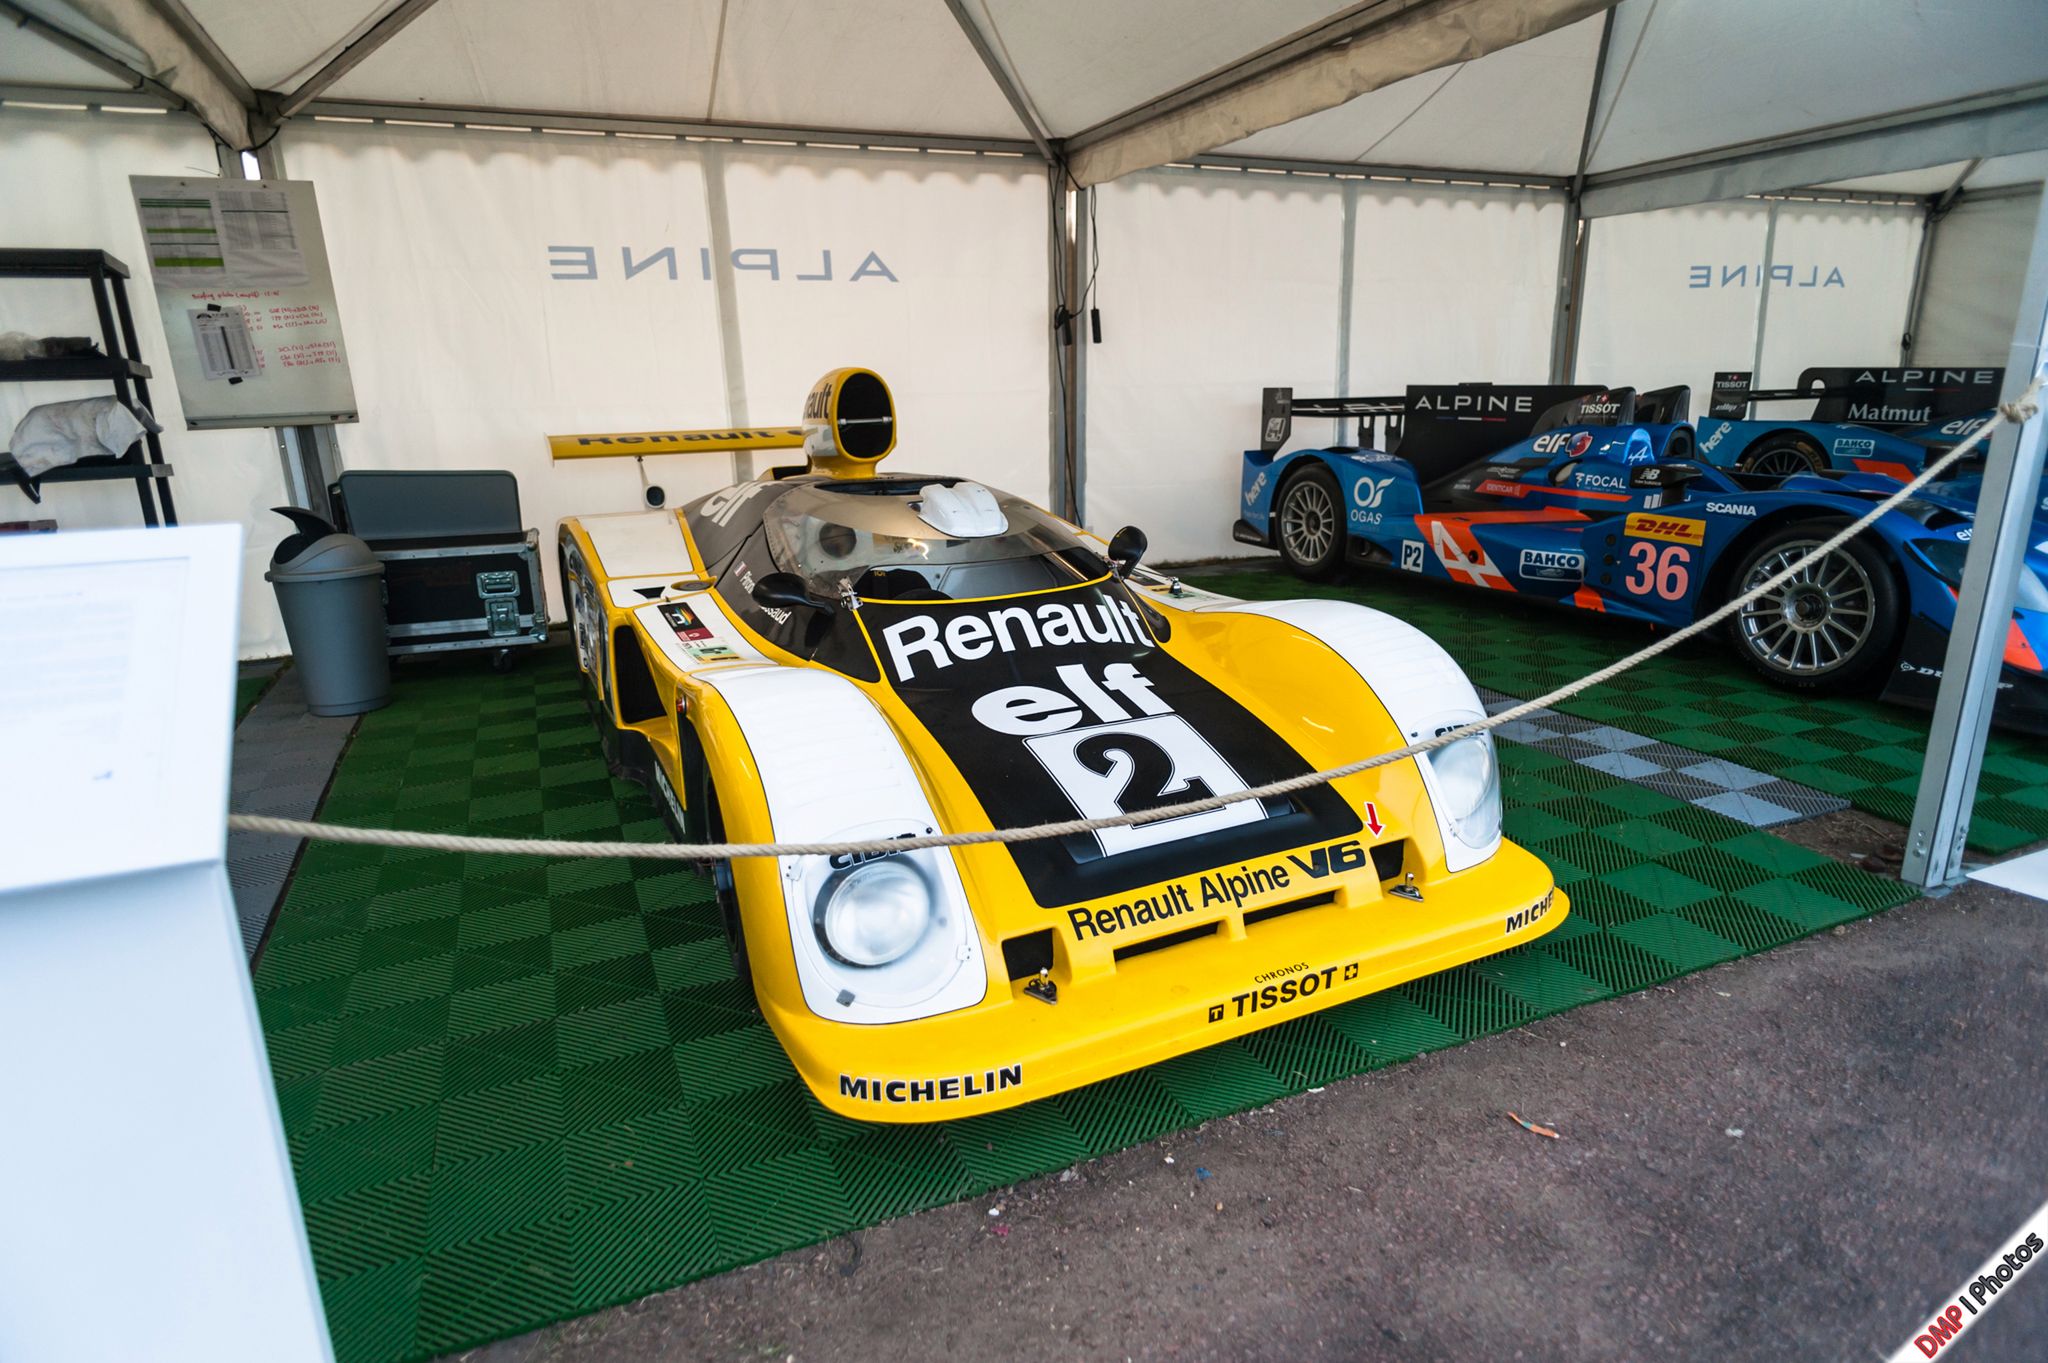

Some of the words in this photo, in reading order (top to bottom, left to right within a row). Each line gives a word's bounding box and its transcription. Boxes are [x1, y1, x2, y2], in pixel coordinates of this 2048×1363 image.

[1855, 370, 1994, 385] ALPINE
[1415, 395, 1532, 413] ALPINE
[1580, 404, 1621, 414] TISSOT
[1847, 402, 1931, 421] Matmut
[1699, 421, 1732, 453] here
[1940, 418, 1989, 436] elf
[578, 431, 775, 446] Renault
[1533, 433, 1571, 454] elf
[1837, 440, 1872, 448] BAHCO
[1244, 471, 1267, 506] here
[1585, 474, 1627, 489] FOCAL
[1350, 509, 1384, 525] OGAS
[1706, 502, 1757, 516] SCANIA
[1635, 518, 1693, 538] DHL
[1403, 544, 1422, 569] P2
[1524, 551, 1580, 569] BAHCO
[1625, 541, 1690, 600] 36
[882, 595, 1155, 682] Renault
[971, 663, 1175, 735] elf
[1073, 731, 1227, 828] 2
[1067, 883, 1194, 941] Renault
[1200, 863, 1290, 908] Alpine
[1287, 840, 1367, 879] V6
[1505, 888, 1555, 934] MICHE
[1254, 962, 1309, 984] CHRONOS
[1231, 967, 1338, 1017] TISSOT
[839, 1063, 1023, 1102] MICHELIN
